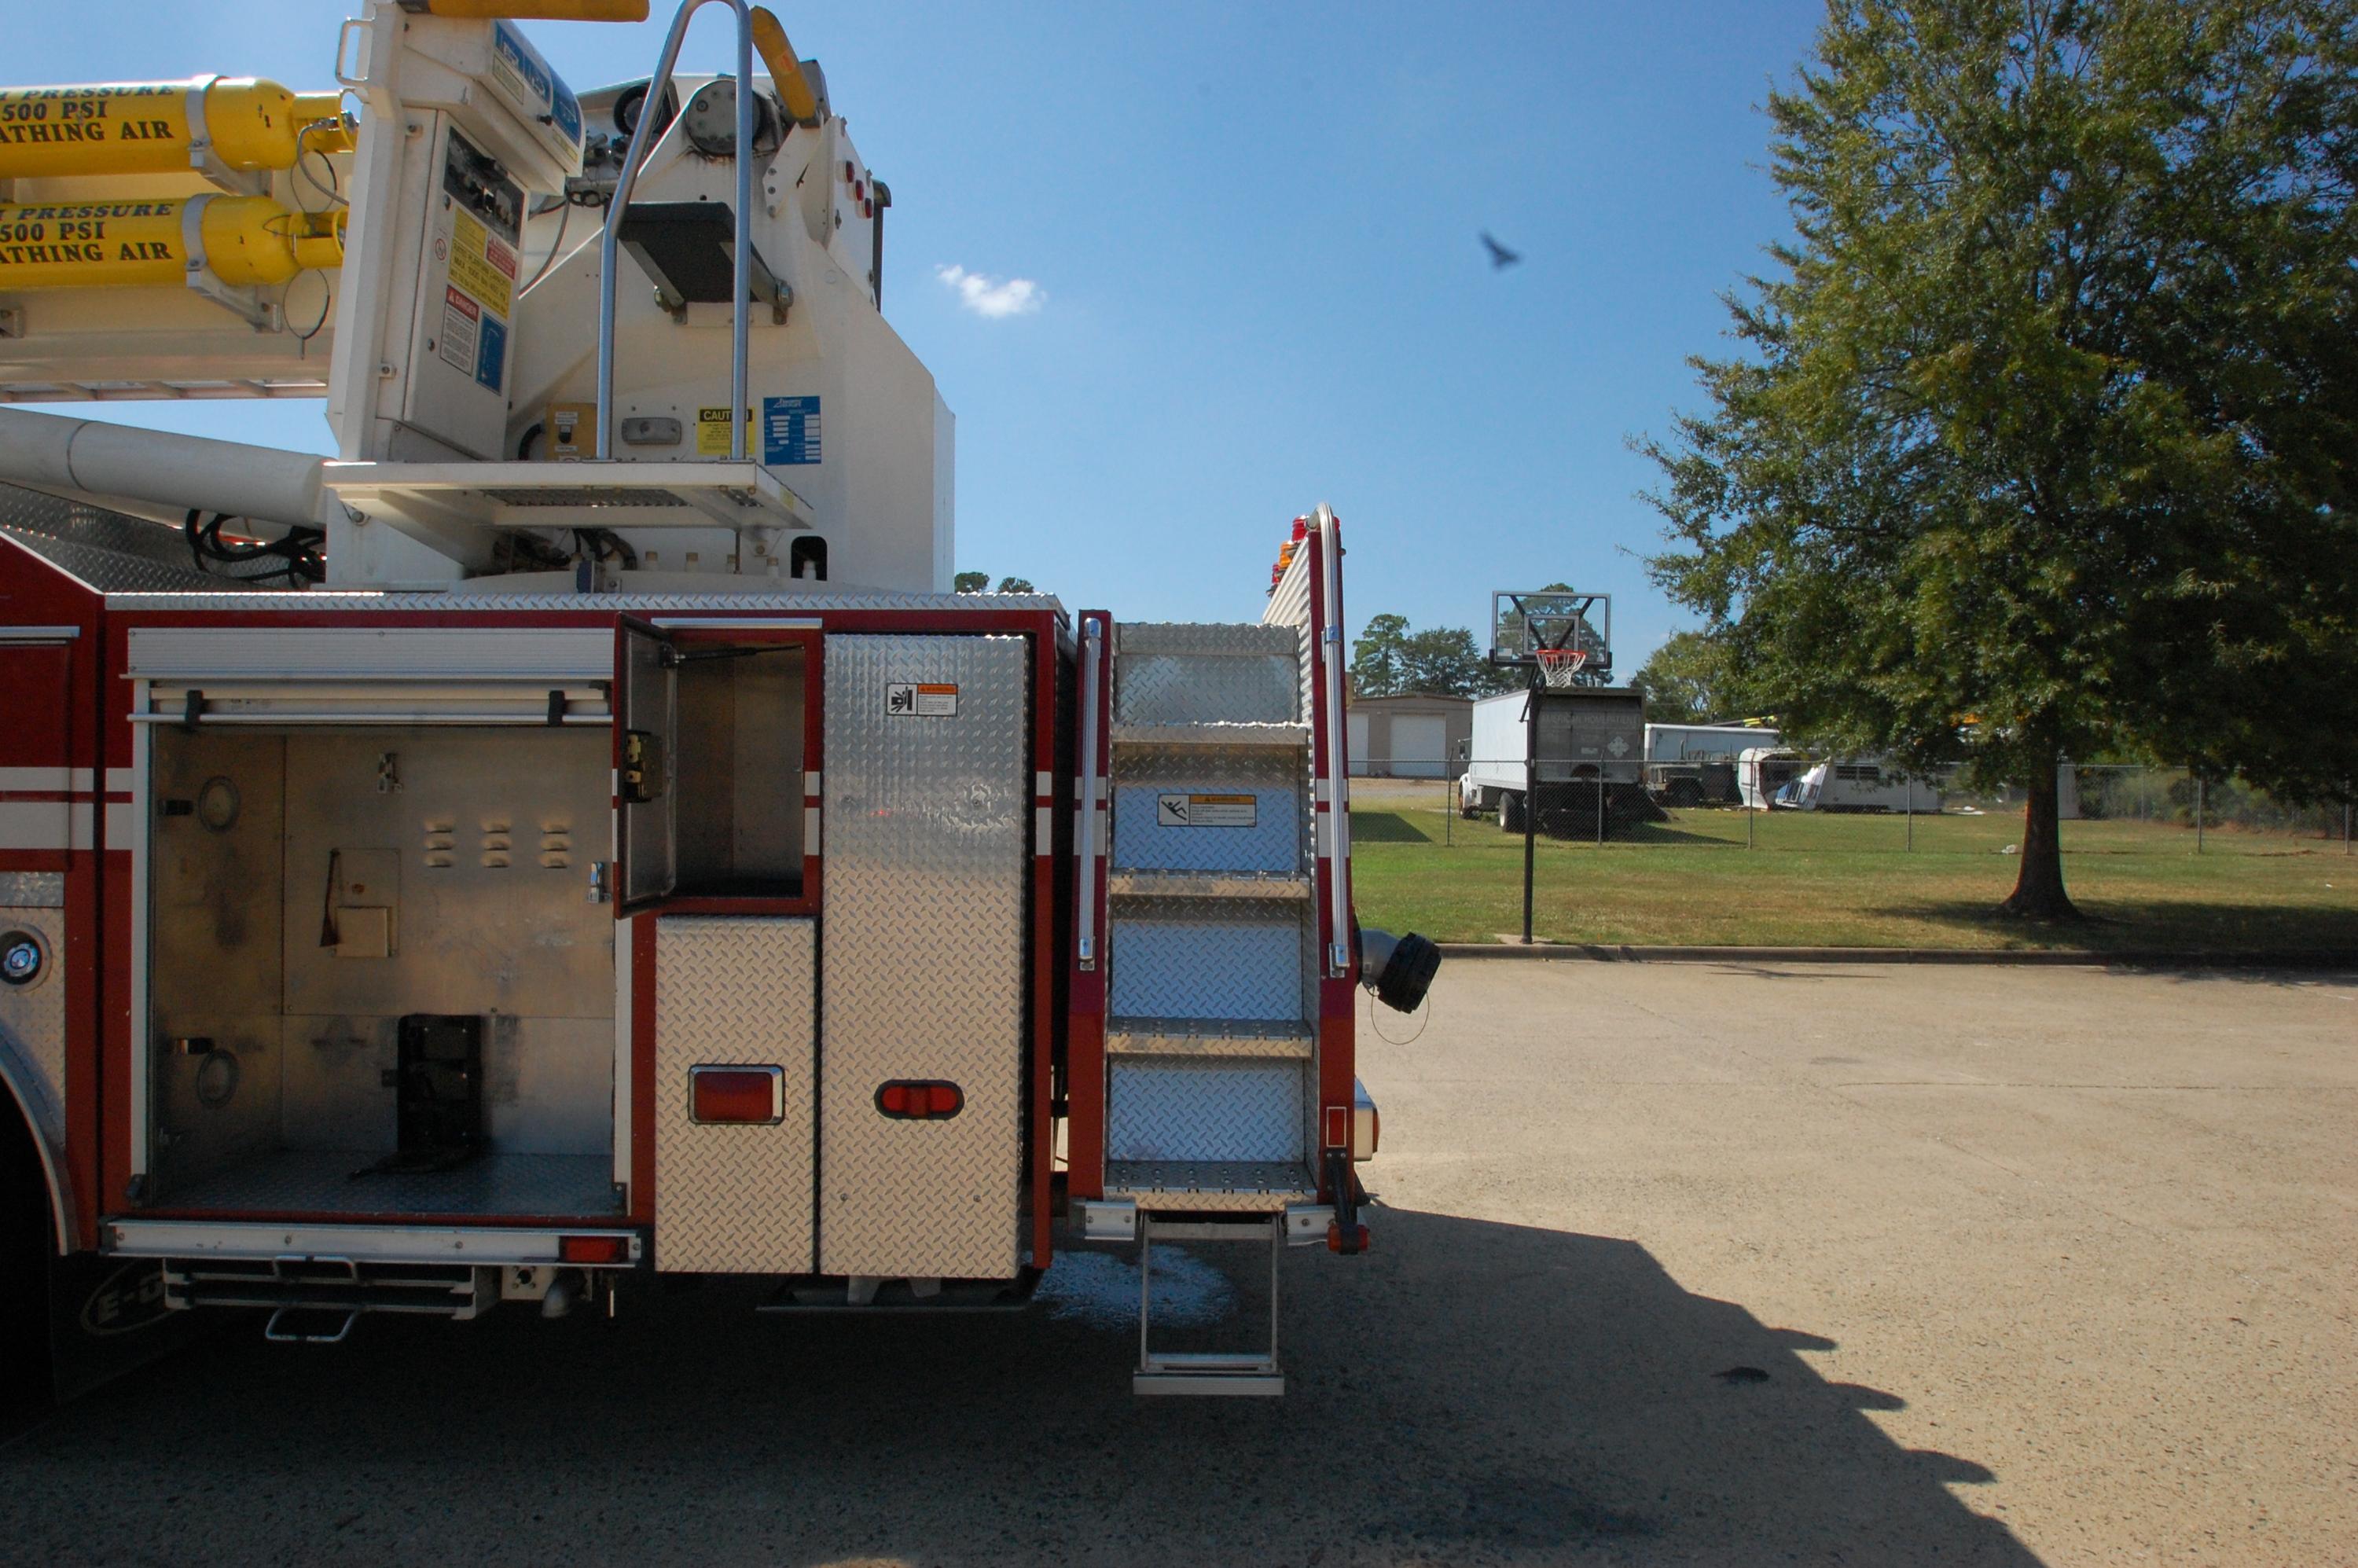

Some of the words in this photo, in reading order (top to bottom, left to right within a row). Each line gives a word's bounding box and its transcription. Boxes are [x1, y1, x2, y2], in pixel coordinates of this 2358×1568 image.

[22, 85, 174, 100] PRESSURE
[61, 101, 108, 119] PSI
[120, 120, 175, 139] AIR
[17, 204, 174, 220] PRESSURE
[59, 221, 105, 241] PSI
[119, 242, 174, 260] AIR
[703, 410, 749, 420] CAUT
